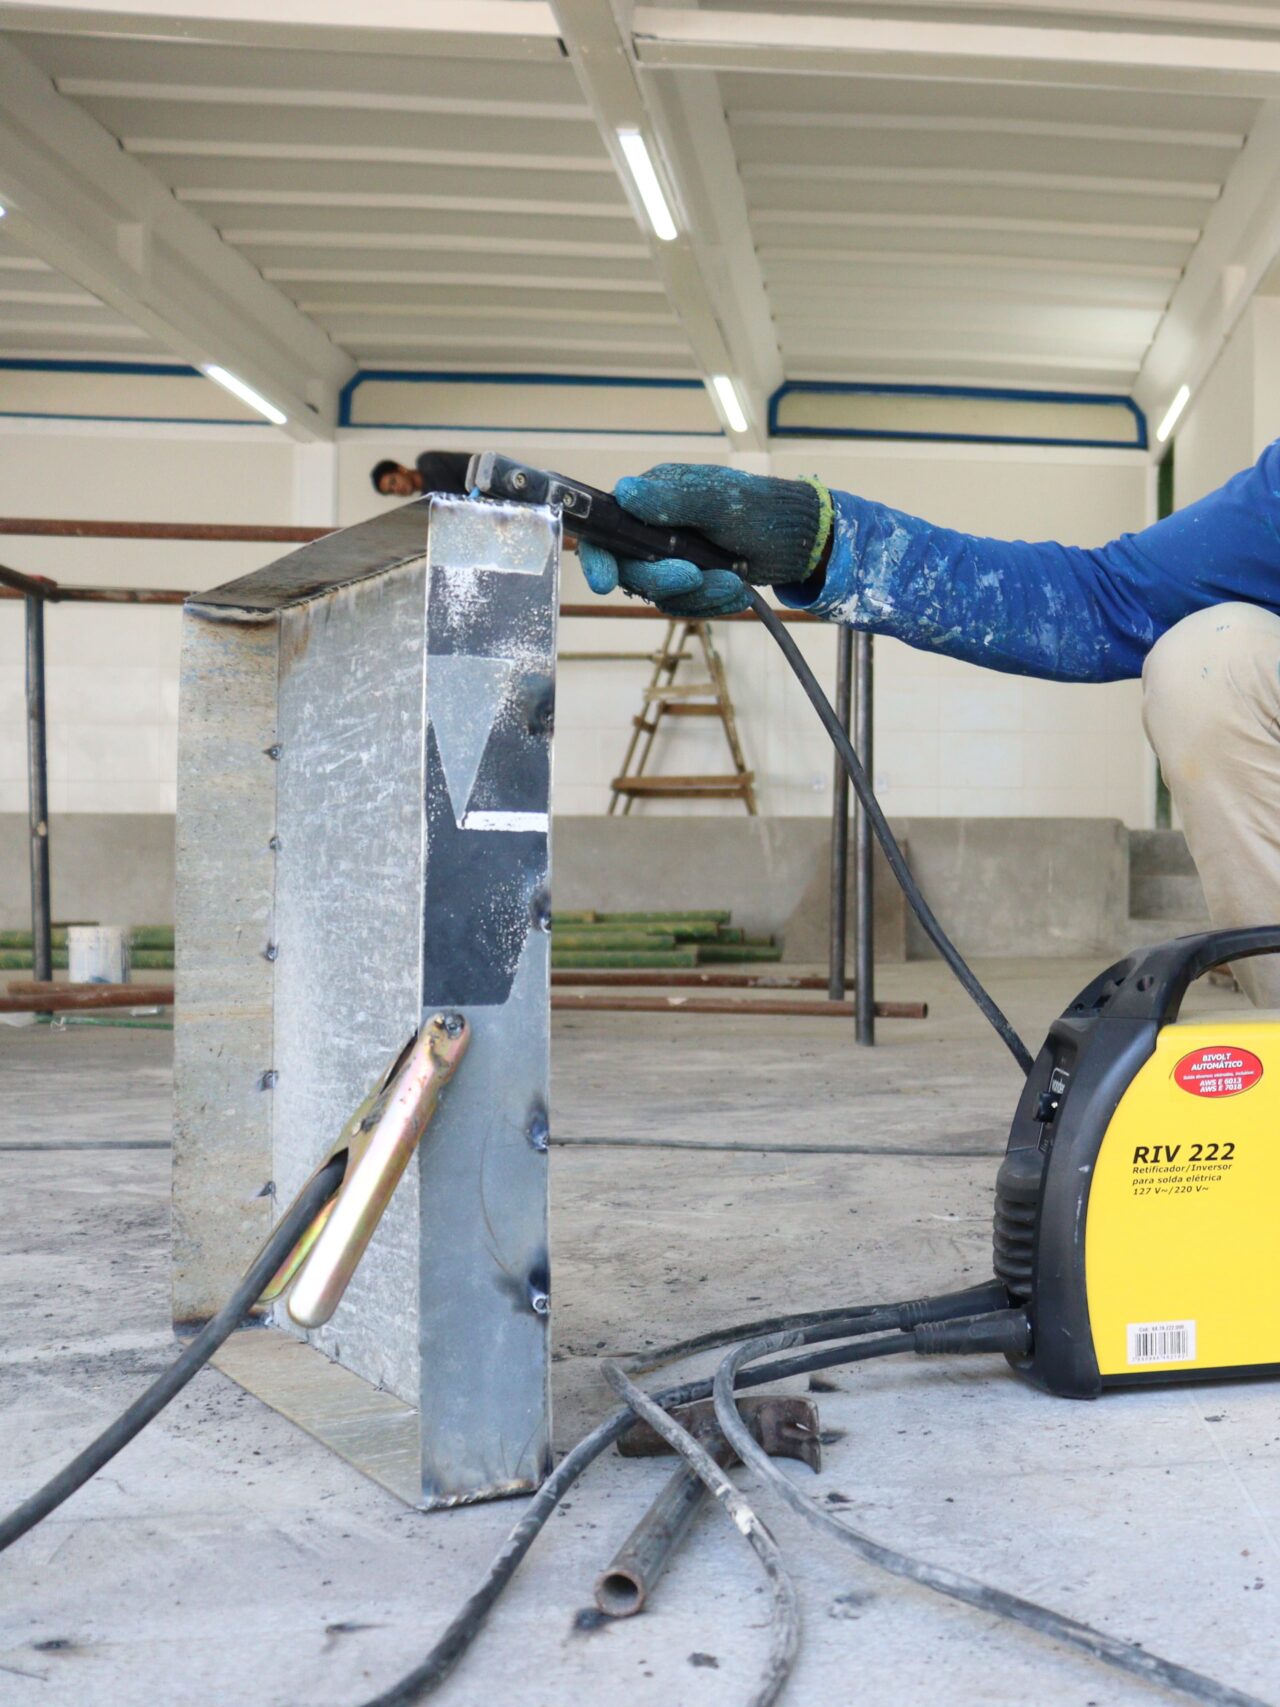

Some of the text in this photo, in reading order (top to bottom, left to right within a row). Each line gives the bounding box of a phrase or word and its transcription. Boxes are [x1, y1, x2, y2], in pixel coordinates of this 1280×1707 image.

[1202, 1053, 1231, 1062] BIVOLT
[1191, 1060, 1243, 1071] AUTOMÁTICO
[1200, 1079, 1217, 1087] AWS
[1200, 1085, 1217, 1093] AWS
[1132, 1142, 1236, 1164] RIV 222
[1132, 1163, 1233, 1174] Retificador/Inversor
[1132, 1173, 1222, 1186] para solda elétrica
[1133, 1187, 1152, 1195] 127
